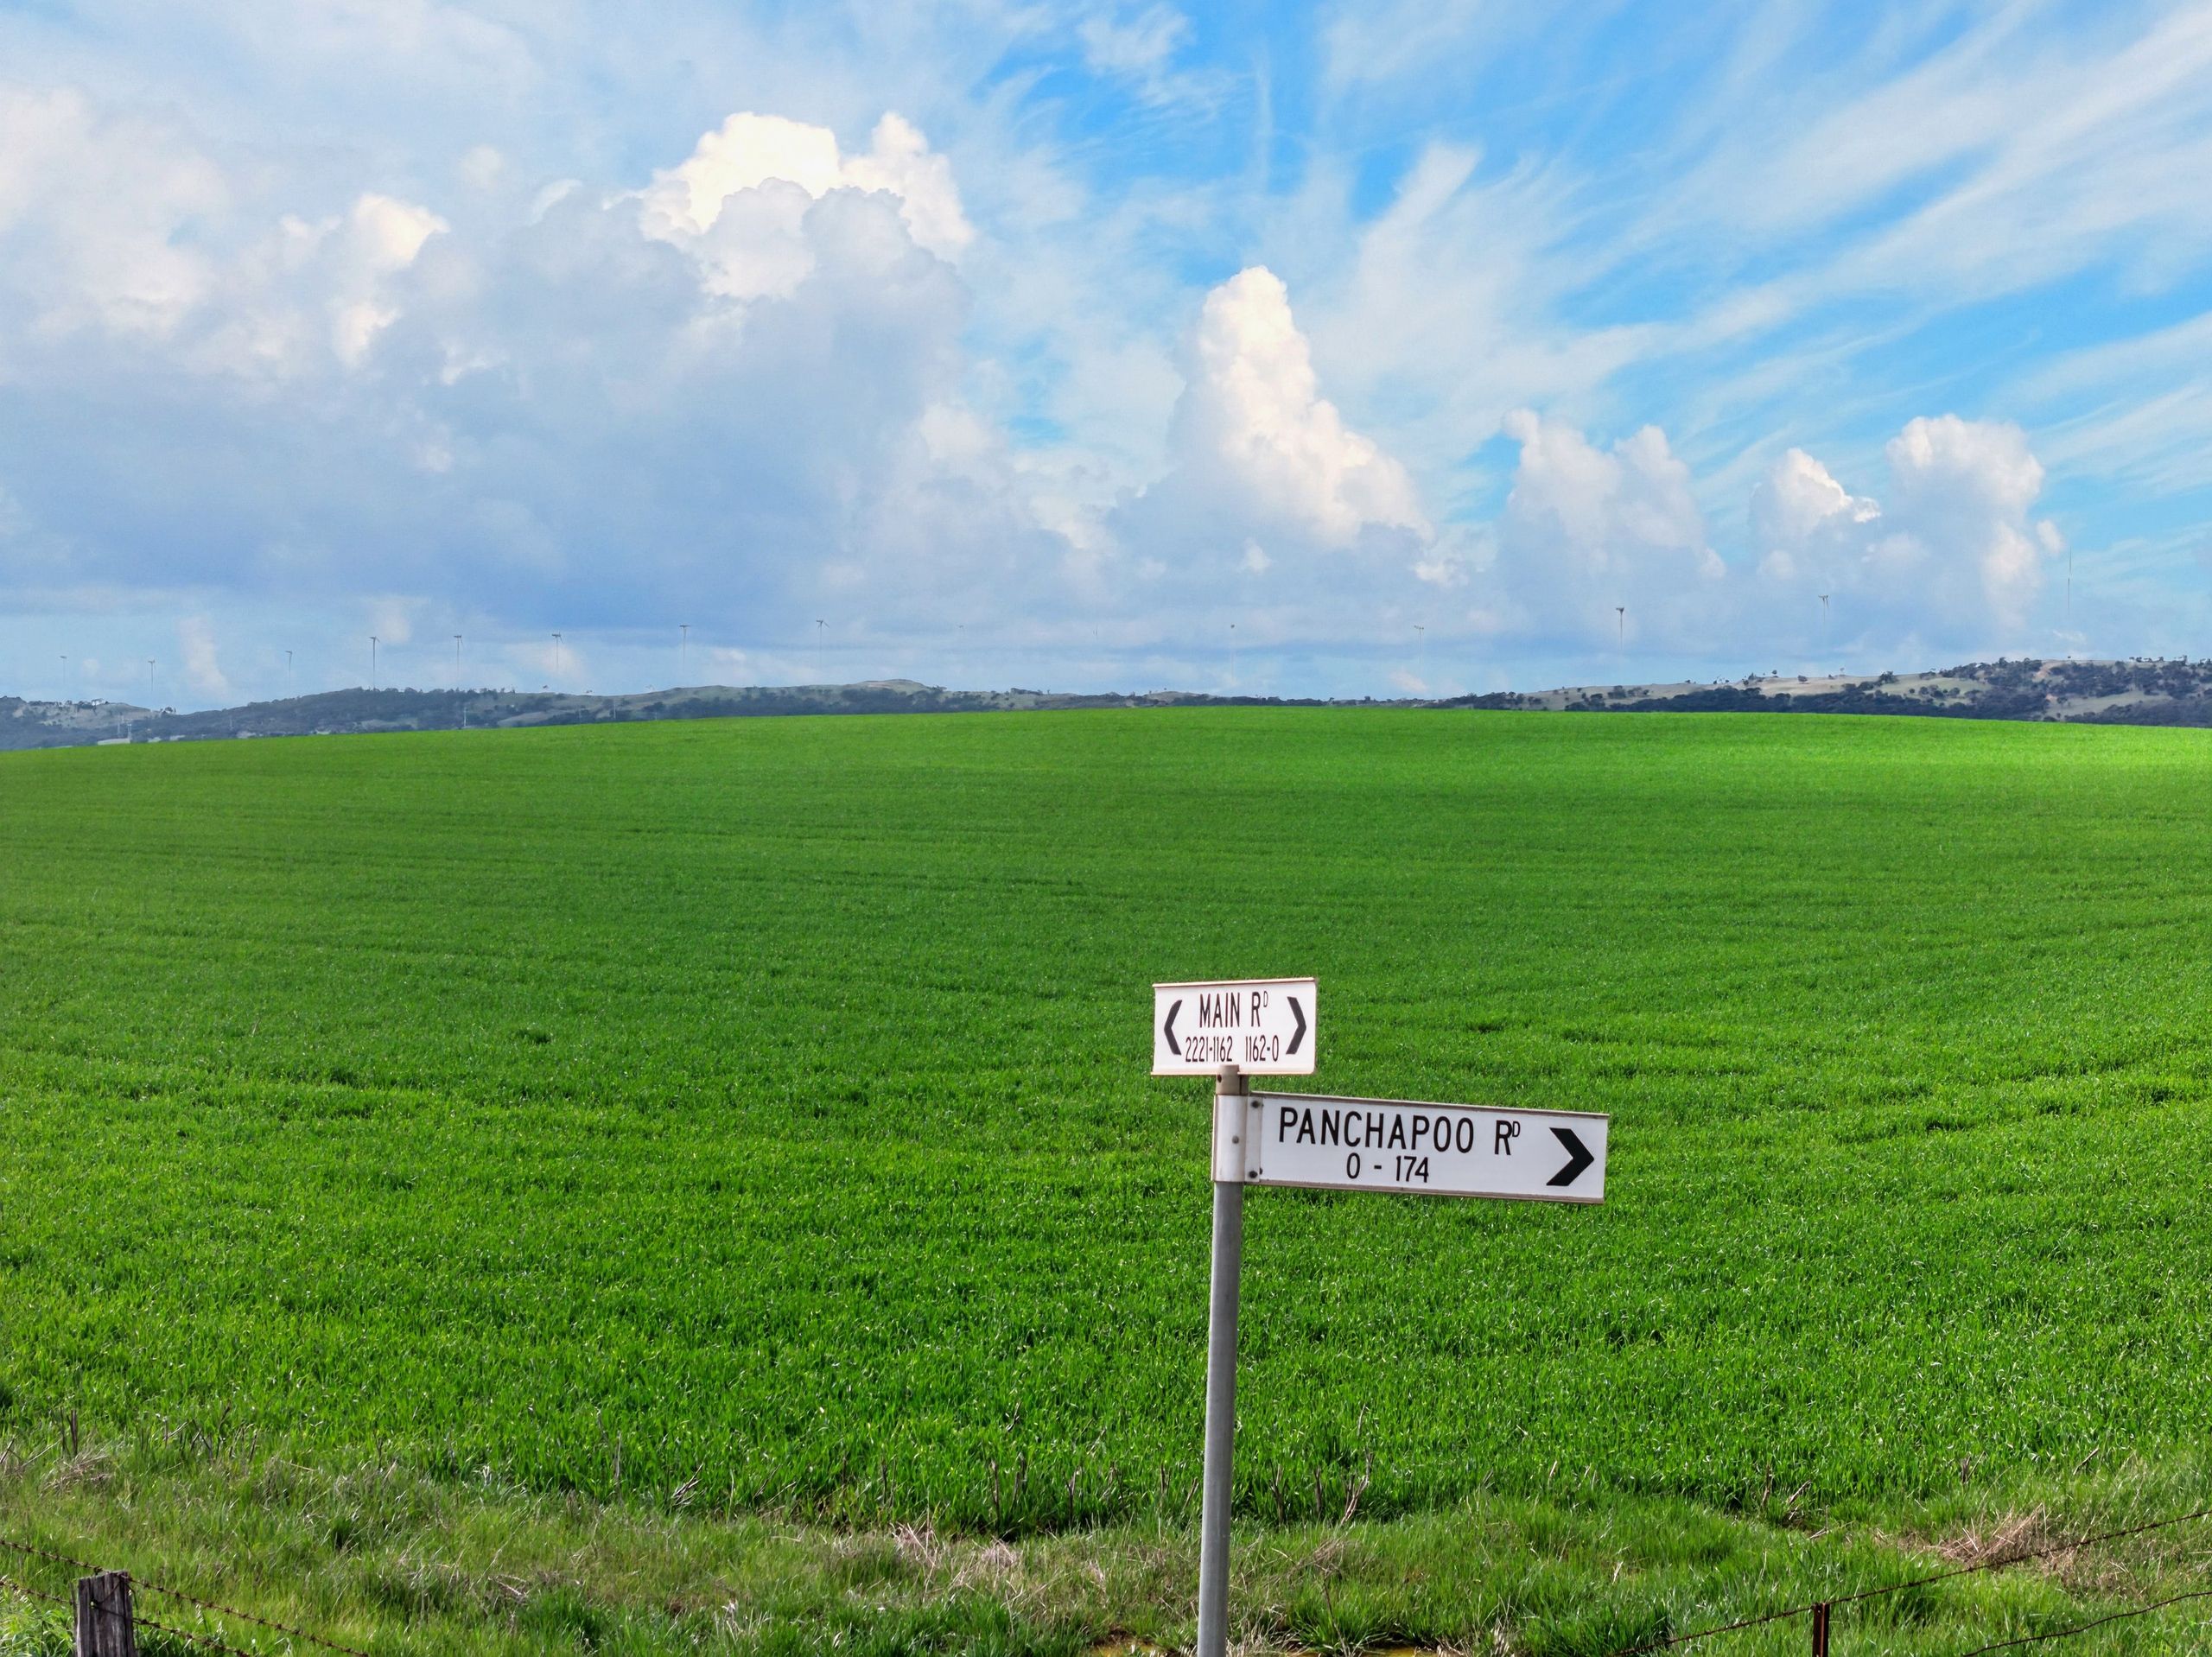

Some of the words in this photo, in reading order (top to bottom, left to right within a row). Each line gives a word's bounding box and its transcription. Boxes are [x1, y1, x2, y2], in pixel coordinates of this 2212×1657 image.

[1199, 992, 1240, 1028] MAIN
[1250, 990, 1268, 1027] RD
[1185, 1035, 1233, 1063] 2221-1162
[1245, 1034, 1280, 1063] 1162-0
[1279, 1107, 1474, 1153] PANCHAPOO
[1494, 1120, 1521, 1156] RD
[1395, 1155, 1430, 1184] 174
